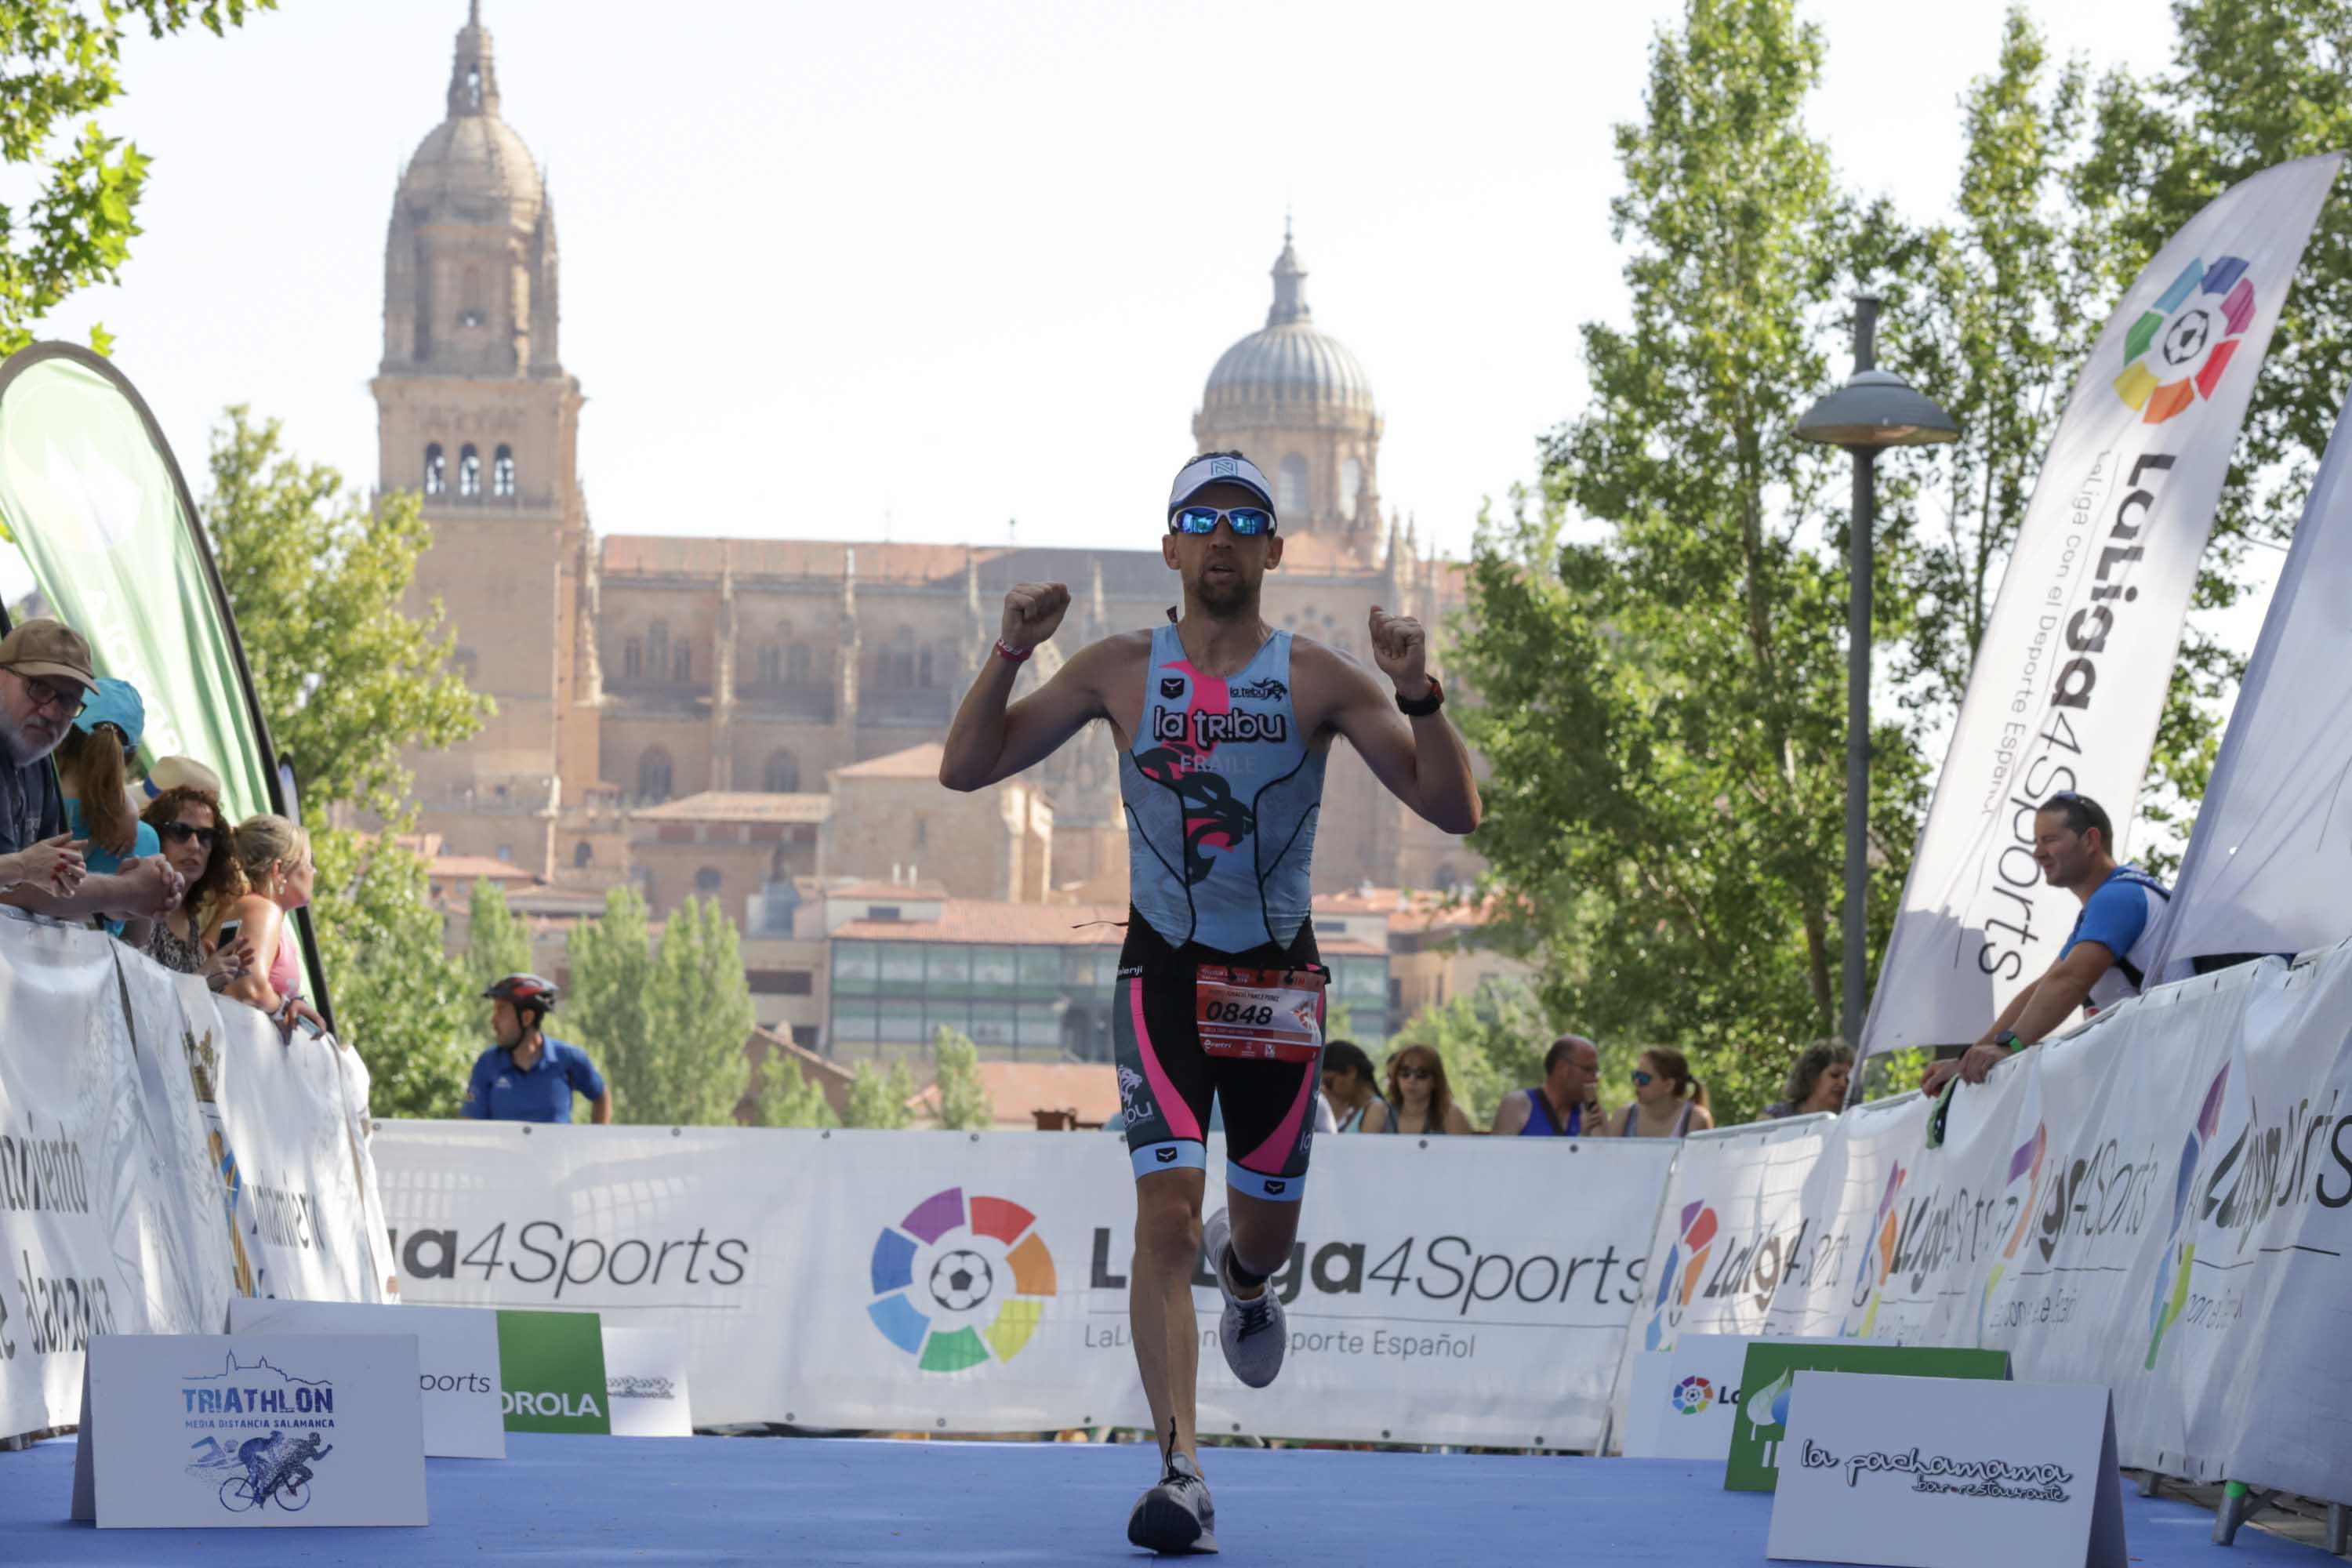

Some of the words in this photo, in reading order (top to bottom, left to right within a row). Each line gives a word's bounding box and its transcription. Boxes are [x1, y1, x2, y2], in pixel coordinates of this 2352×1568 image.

[2055, 535, 2082, 578] con
[2045, 586, 2063, 607] el
[2011, 615, 2057, 713] Deporte
[1153, 704, 1188, 741] la
[1180, 754, 1255, 773] FRAILE
[1206, 1001, 1273, 1025] 0848
[387, 1220, 750, 1299] a4Sports
[1373, 1330, 1475, 1360] Español
[182, 1387, 333, 1414] TRIATHLON
[185, 1420, 216, 1428] MEDIA
[219, 1420, 270, 1428] DISTANCIA
[273, 1419, 335, 1428] SALAMANCA
[1801, 1439, 1839, 1468] la
[1844, 1447, 2074, 1488] pachamama
[1957, 1479, 2071, 1503] restaurante
